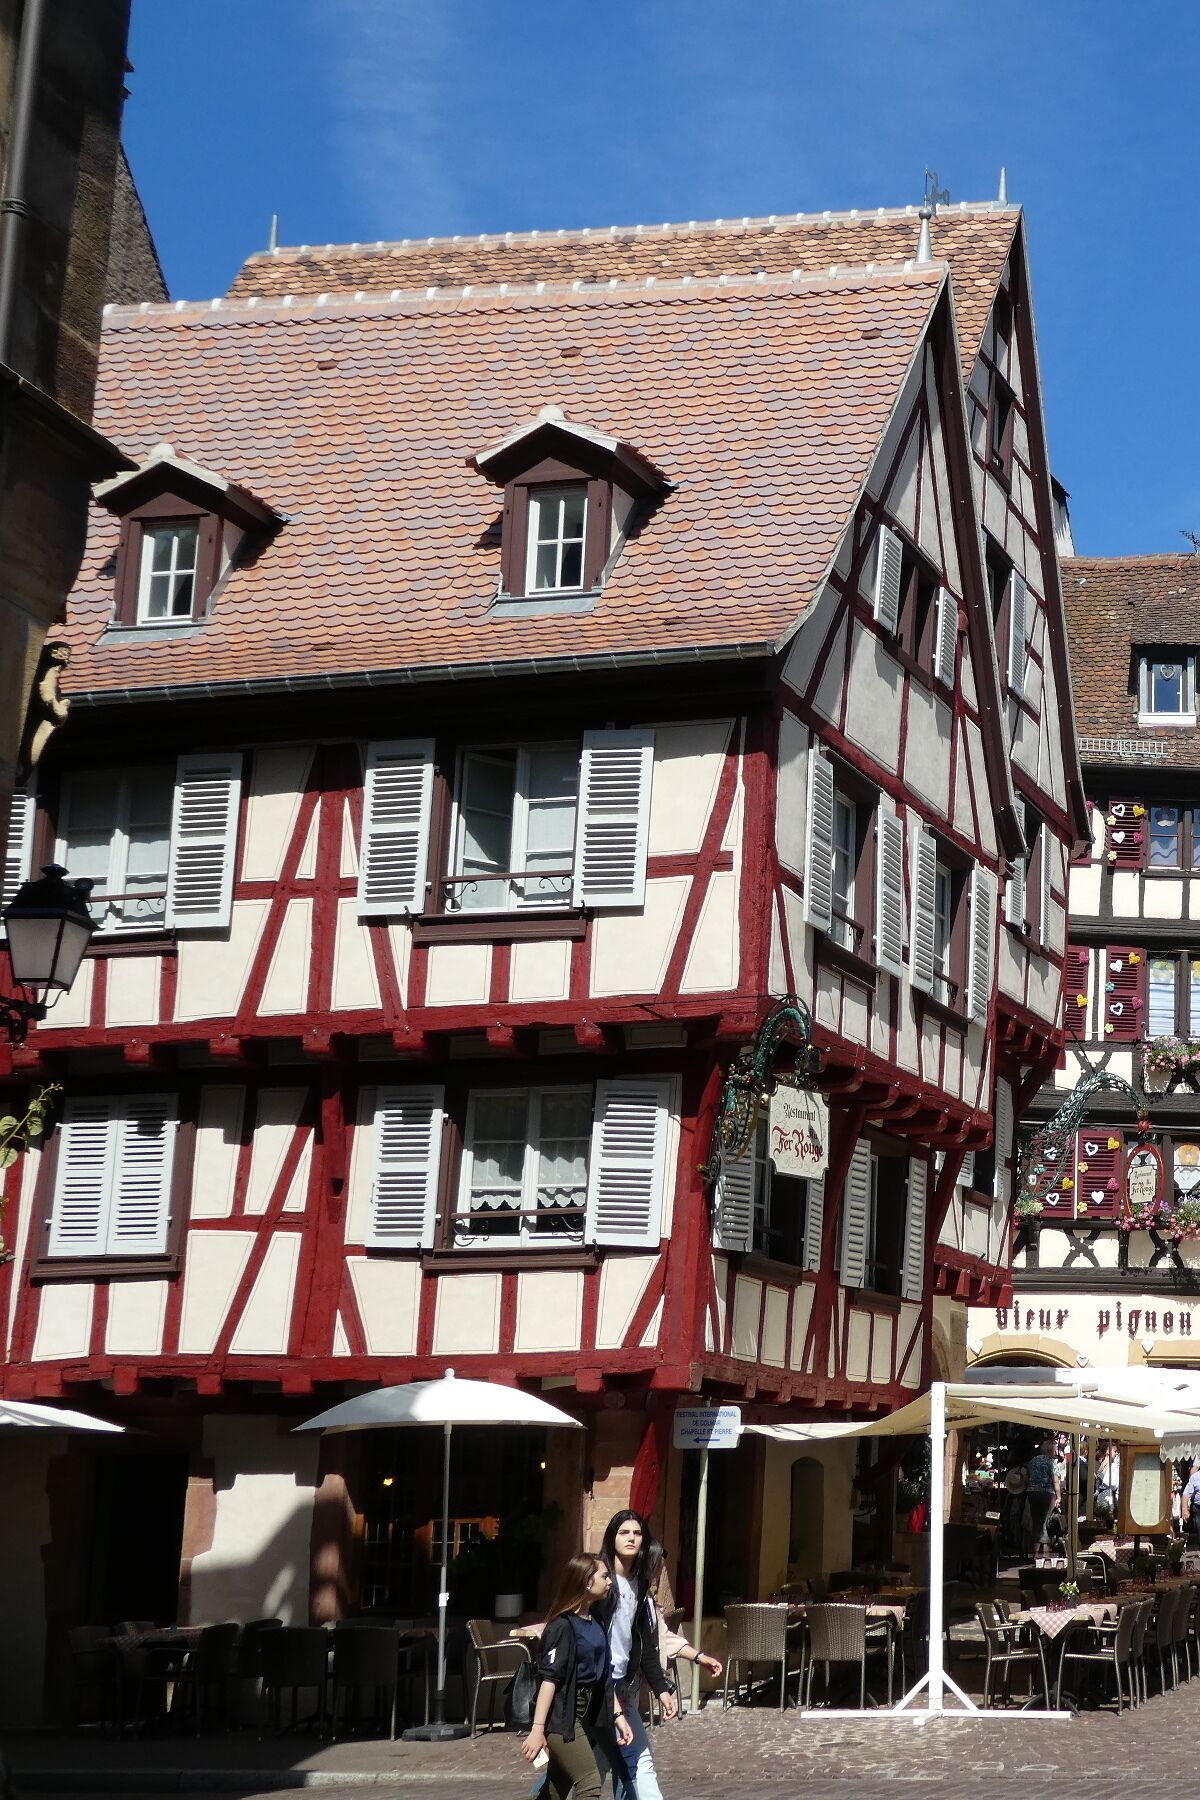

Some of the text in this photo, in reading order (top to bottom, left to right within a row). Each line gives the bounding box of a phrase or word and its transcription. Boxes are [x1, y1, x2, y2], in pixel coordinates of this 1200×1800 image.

[772, 1125, 824, 1163] Fer Rouge
[1097, 1301, 1192, 1338] pignon
[699, 1410, 737, 1418] INTERNATIONAL
